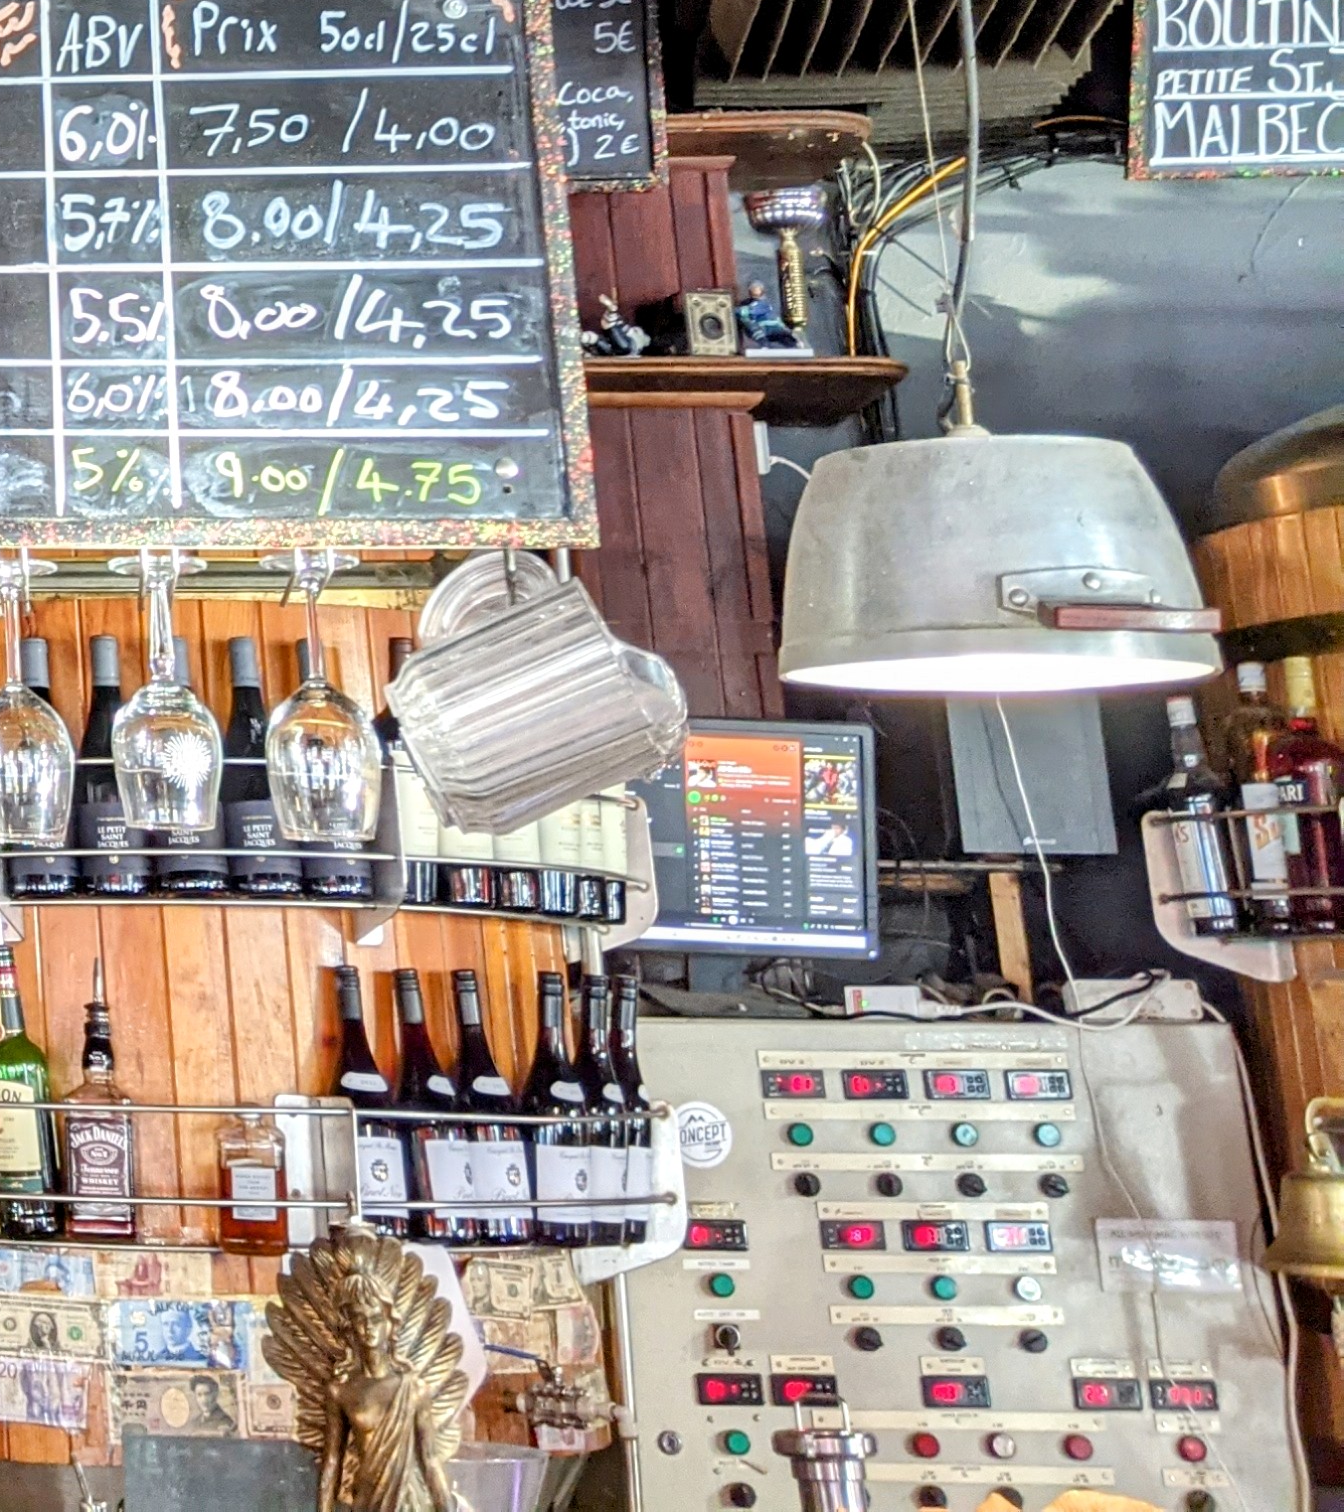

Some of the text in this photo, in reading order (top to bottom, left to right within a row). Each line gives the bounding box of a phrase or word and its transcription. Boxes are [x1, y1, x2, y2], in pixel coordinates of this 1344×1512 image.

[55, 18, 140, 73] ABV
[192, 0, 278, 56] Prix
[593, 21, 637, 54] 5€
[1156, 66, 1254, 97] PETITE
[1154, 100, 1344, 159] MALBEC
[593, 134, 640, 161] 2€
[97, 839, 129, 849] JACQUES
[101, 833, 124, 841] SAINT
[243, 838, 276, 848] JACQUES
[247, 832, 271, 841] SAINT
[70, 1129, 93, 1149] JACK
[680, 1121, 727, 1147] ONCEPT
[135, 1331, 149, 1353] 5
